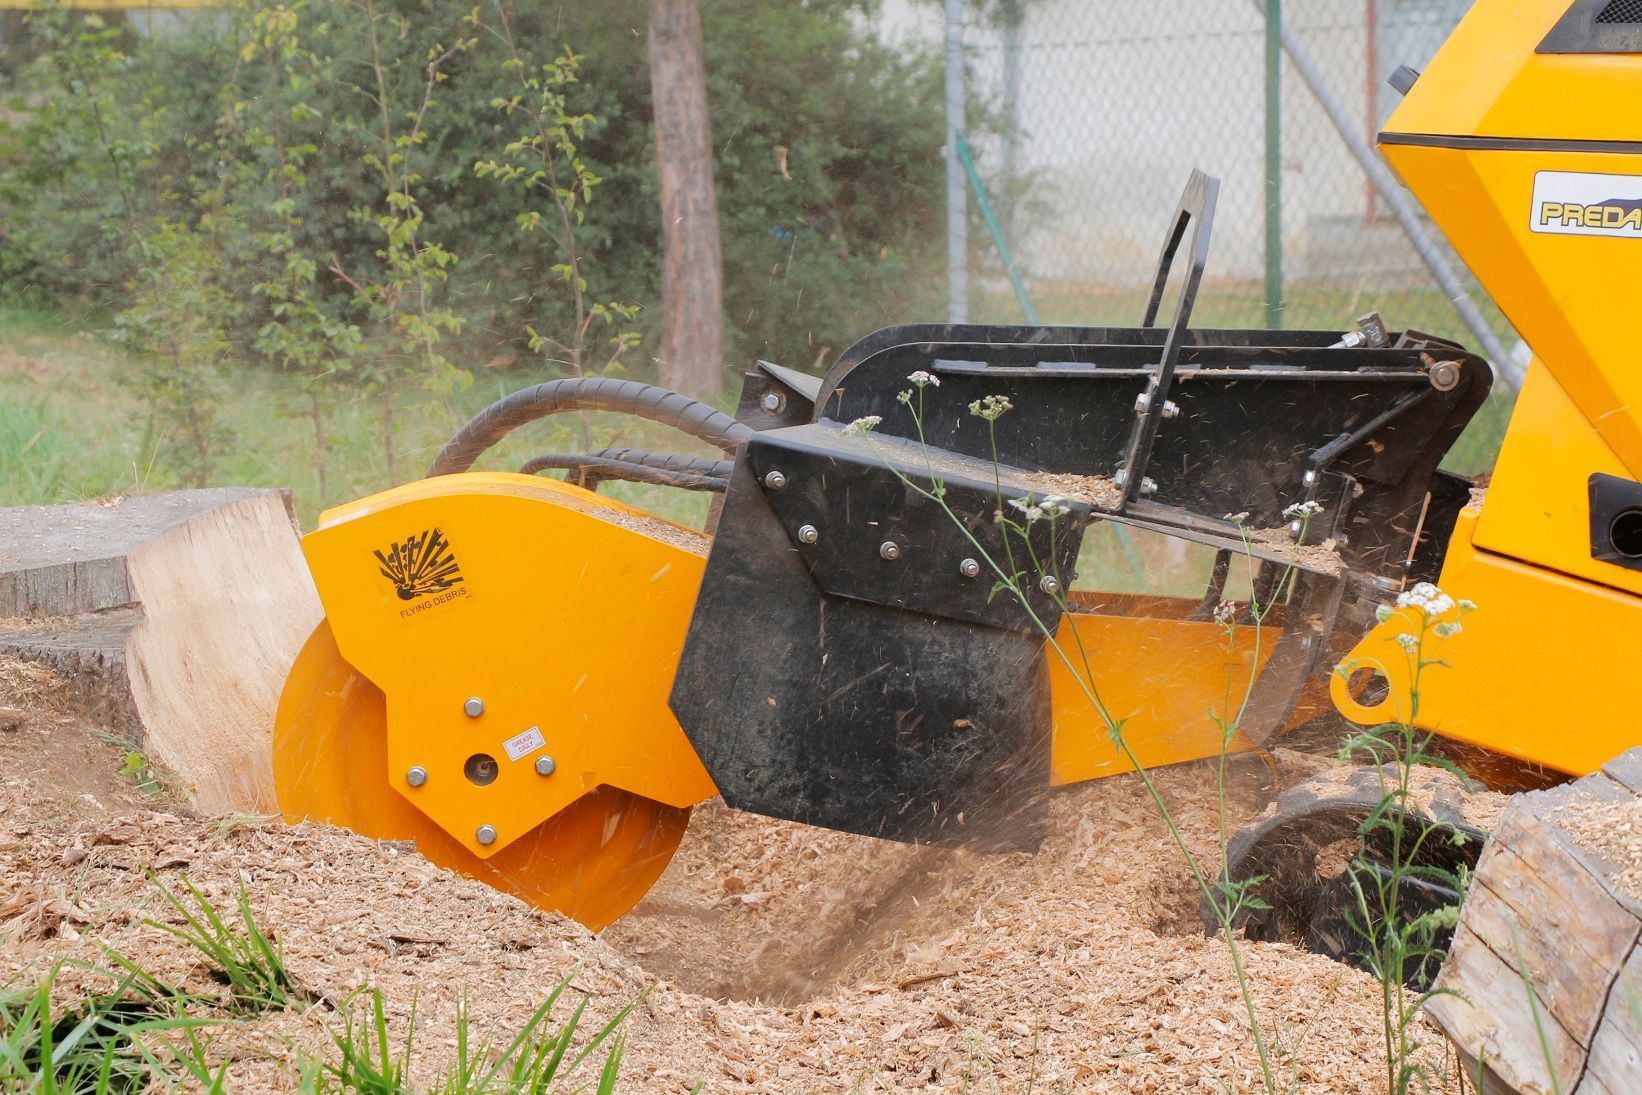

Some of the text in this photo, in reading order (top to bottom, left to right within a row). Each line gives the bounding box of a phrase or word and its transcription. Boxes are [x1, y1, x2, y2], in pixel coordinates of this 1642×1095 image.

[400, 587, 467, 619] FLYING DEBRIS
[512, 734, 533, 748] GREASE
[518, 741, 534, 752] DAILY
